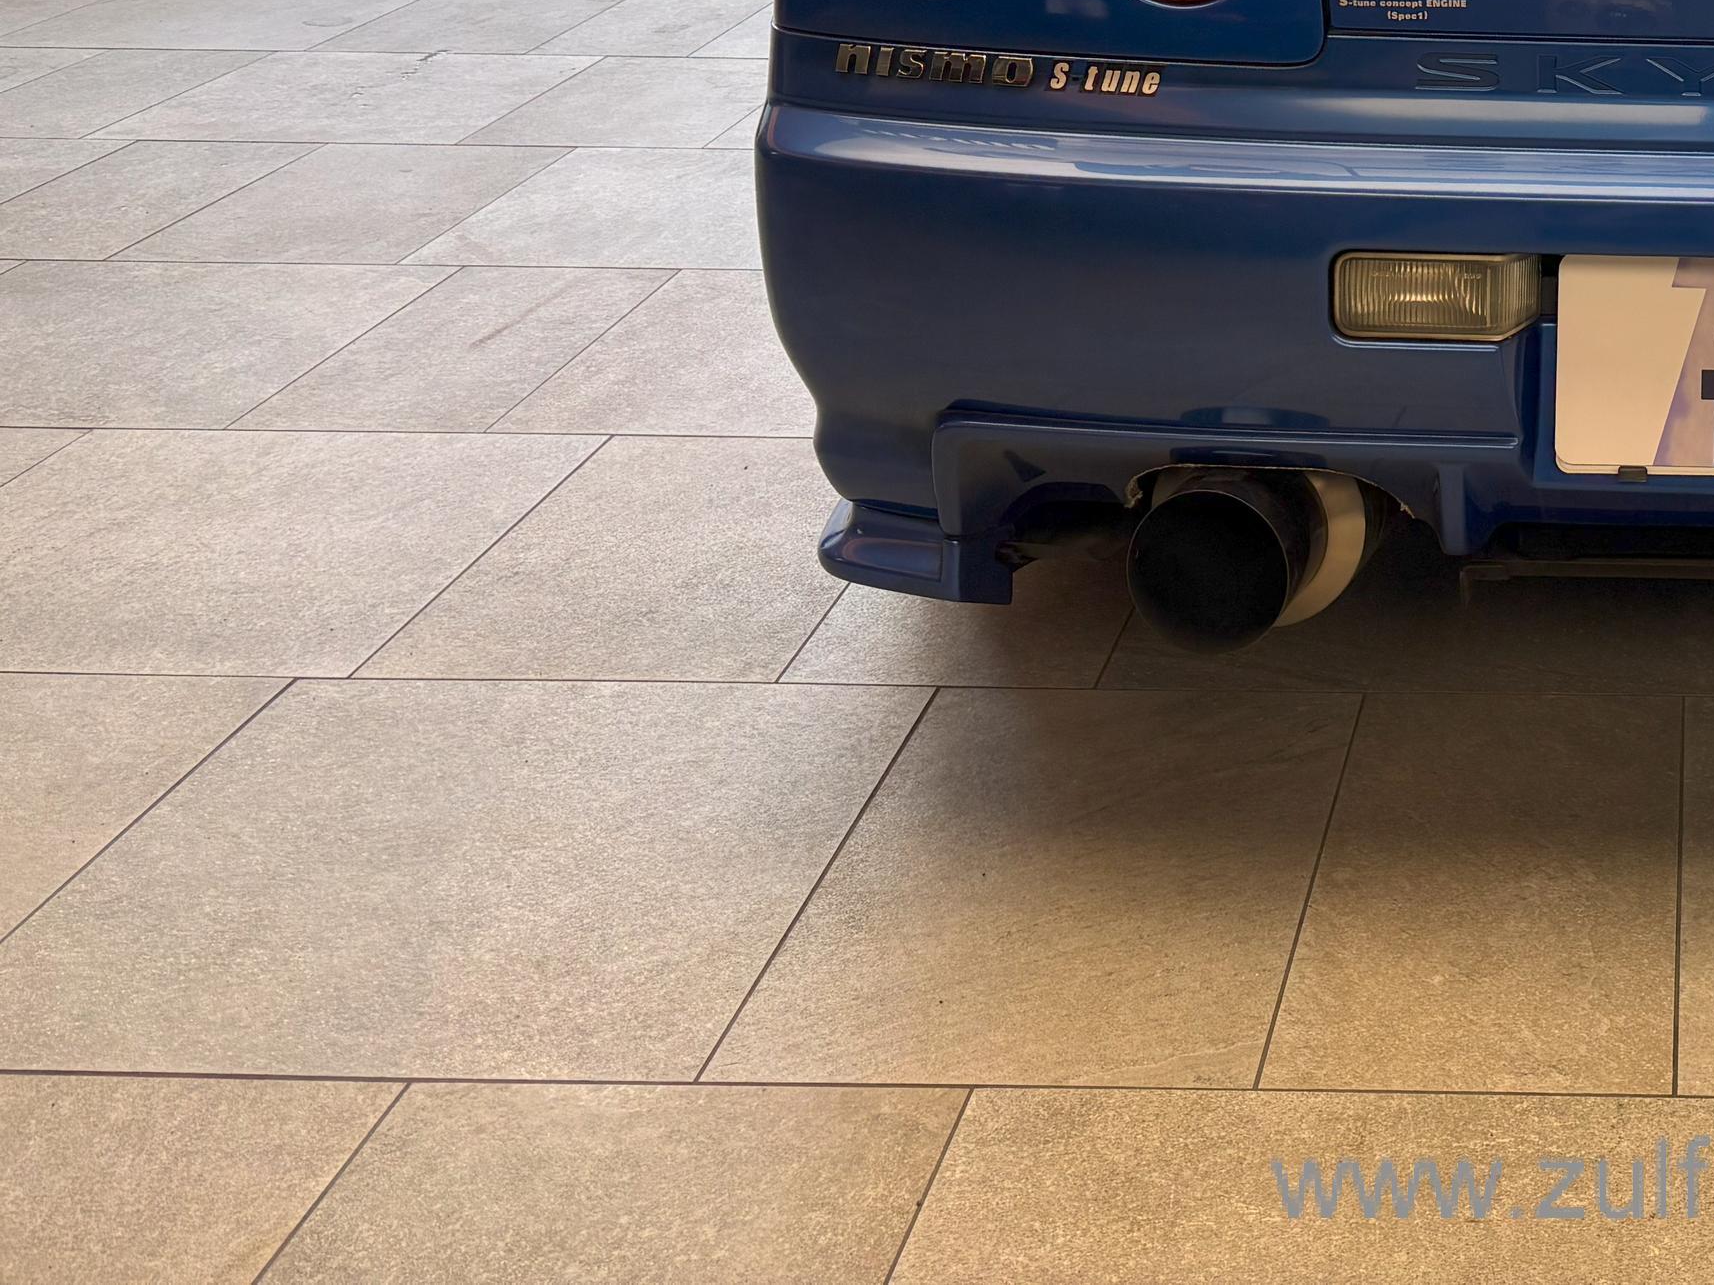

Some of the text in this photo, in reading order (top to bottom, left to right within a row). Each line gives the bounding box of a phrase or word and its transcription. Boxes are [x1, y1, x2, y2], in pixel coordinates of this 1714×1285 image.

[1379, 0, 1424, 9] concept
[1426, 0, 1468, 9] ENGINE
[1386, 10, 1428, 21] (Spec1)
